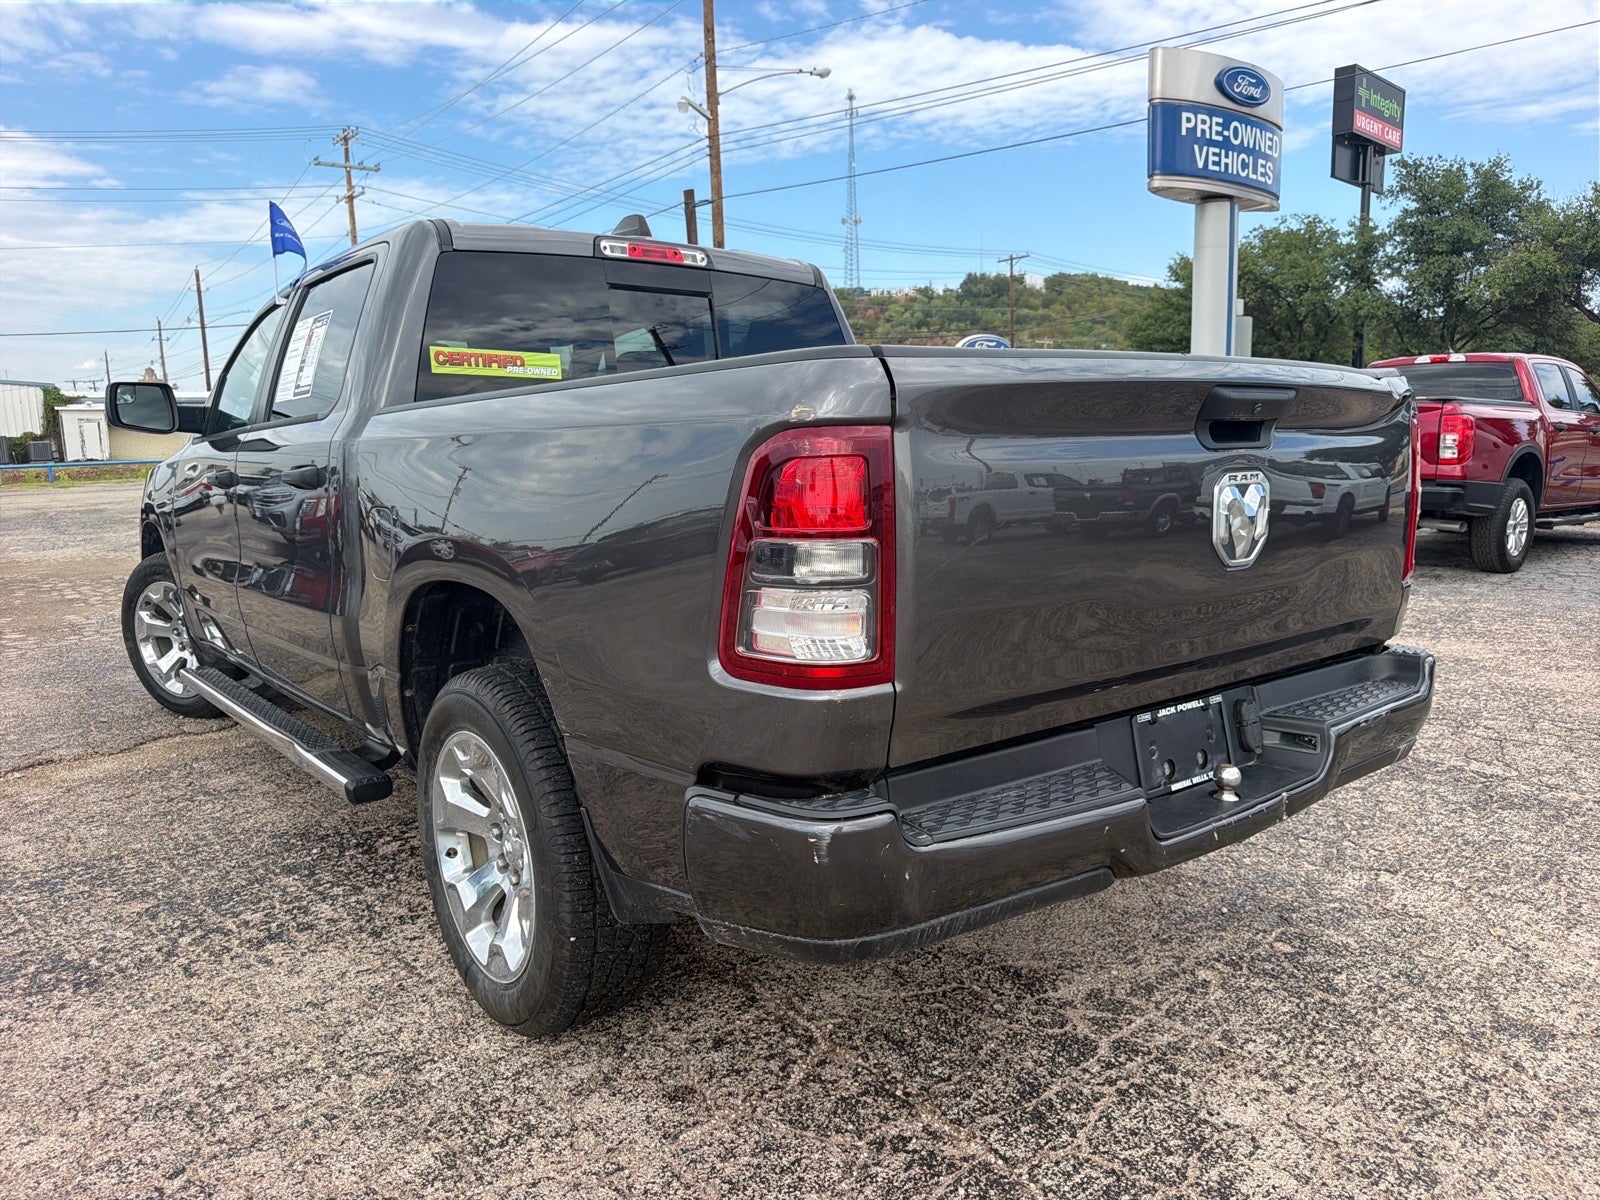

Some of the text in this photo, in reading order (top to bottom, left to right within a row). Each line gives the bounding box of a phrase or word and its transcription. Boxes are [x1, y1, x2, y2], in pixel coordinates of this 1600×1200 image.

[1233, 74, 1263, 98] Ford
[1370, 88, 1402, 122] Integrity
[1181, 112, 1279, 158] PRE-OWNED
[1356, 114, 1401, 144] URGENT CARE
[1194, 145, 1273, 185] VEHICLES
[433, 350, 525, 369] CERTIFIED
[506, 366, 558, 376] PRE-OWNED
[1228, 473, 1259, 482] RAM
[1157, 706, 1176, 717] JACK
[1177, 699, 1205, 712] POWELL
